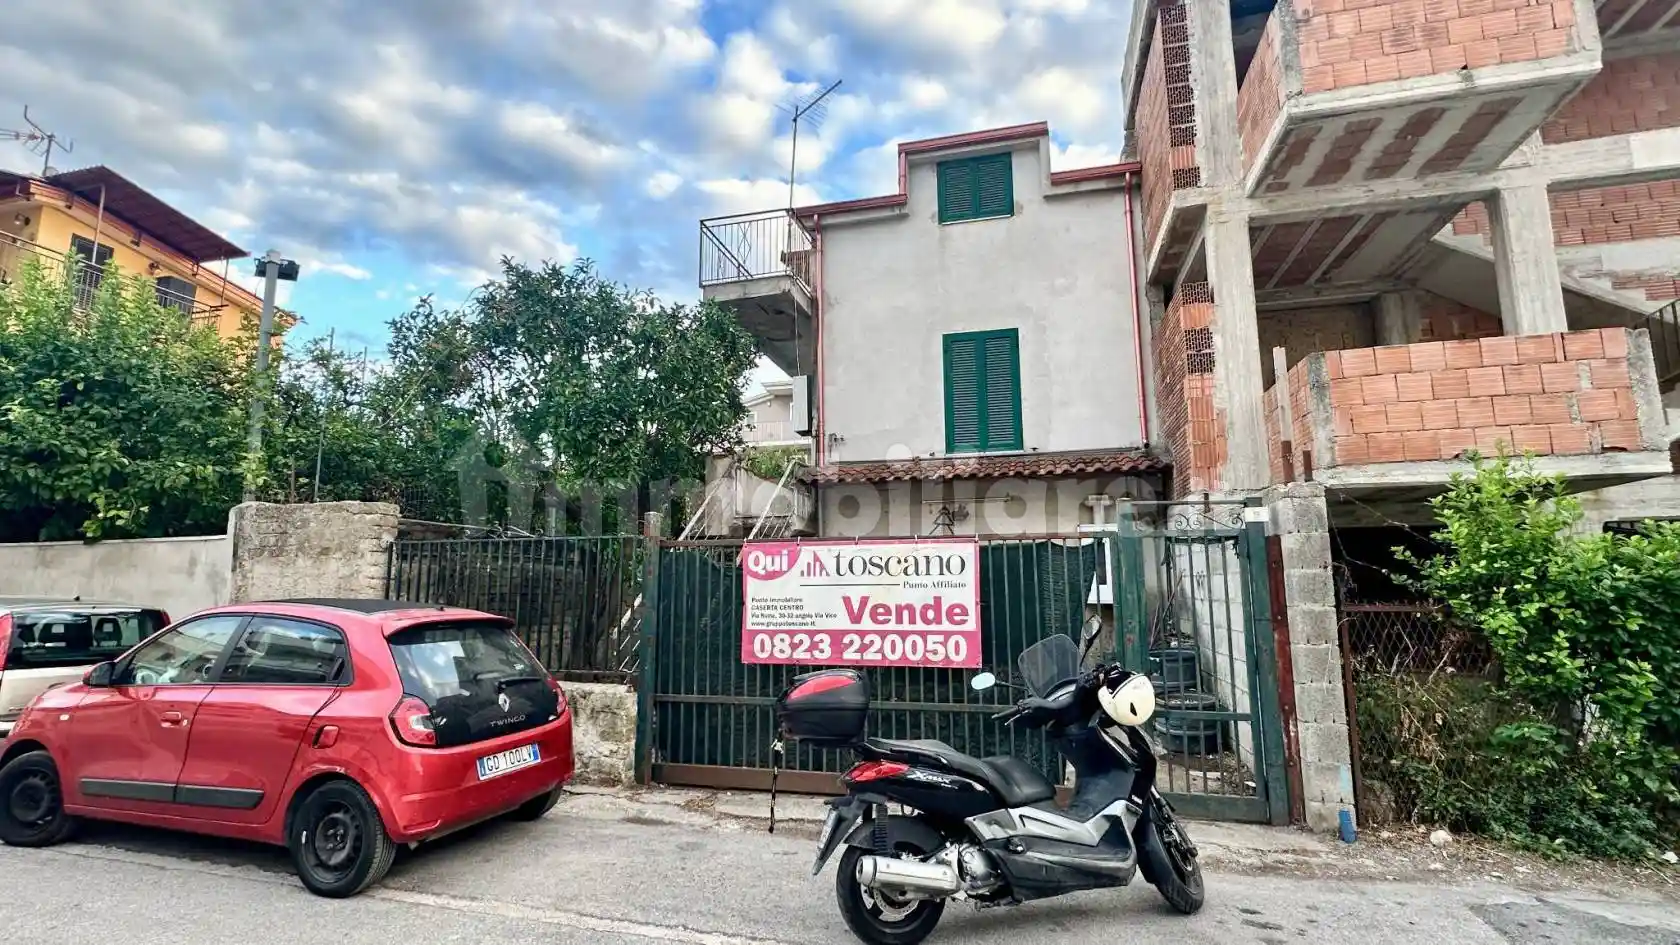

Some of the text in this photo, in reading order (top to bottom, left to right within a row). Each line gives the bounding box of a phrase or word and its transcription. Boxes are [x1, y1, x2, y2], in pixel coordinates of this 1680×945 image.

[749, 550, 788, 575] Qui
[833, 550, 966, 577] toscano
[903, 580, 967, 589] Punto Affiliato
[841, 595, 969, 626] Vende
[753, 632, 968, 662] 0823 220050
[489, 714, 526, 727] TWINGO
[486, 755, 500, 772] GD
[503, 745, 533, 766] 100LV
